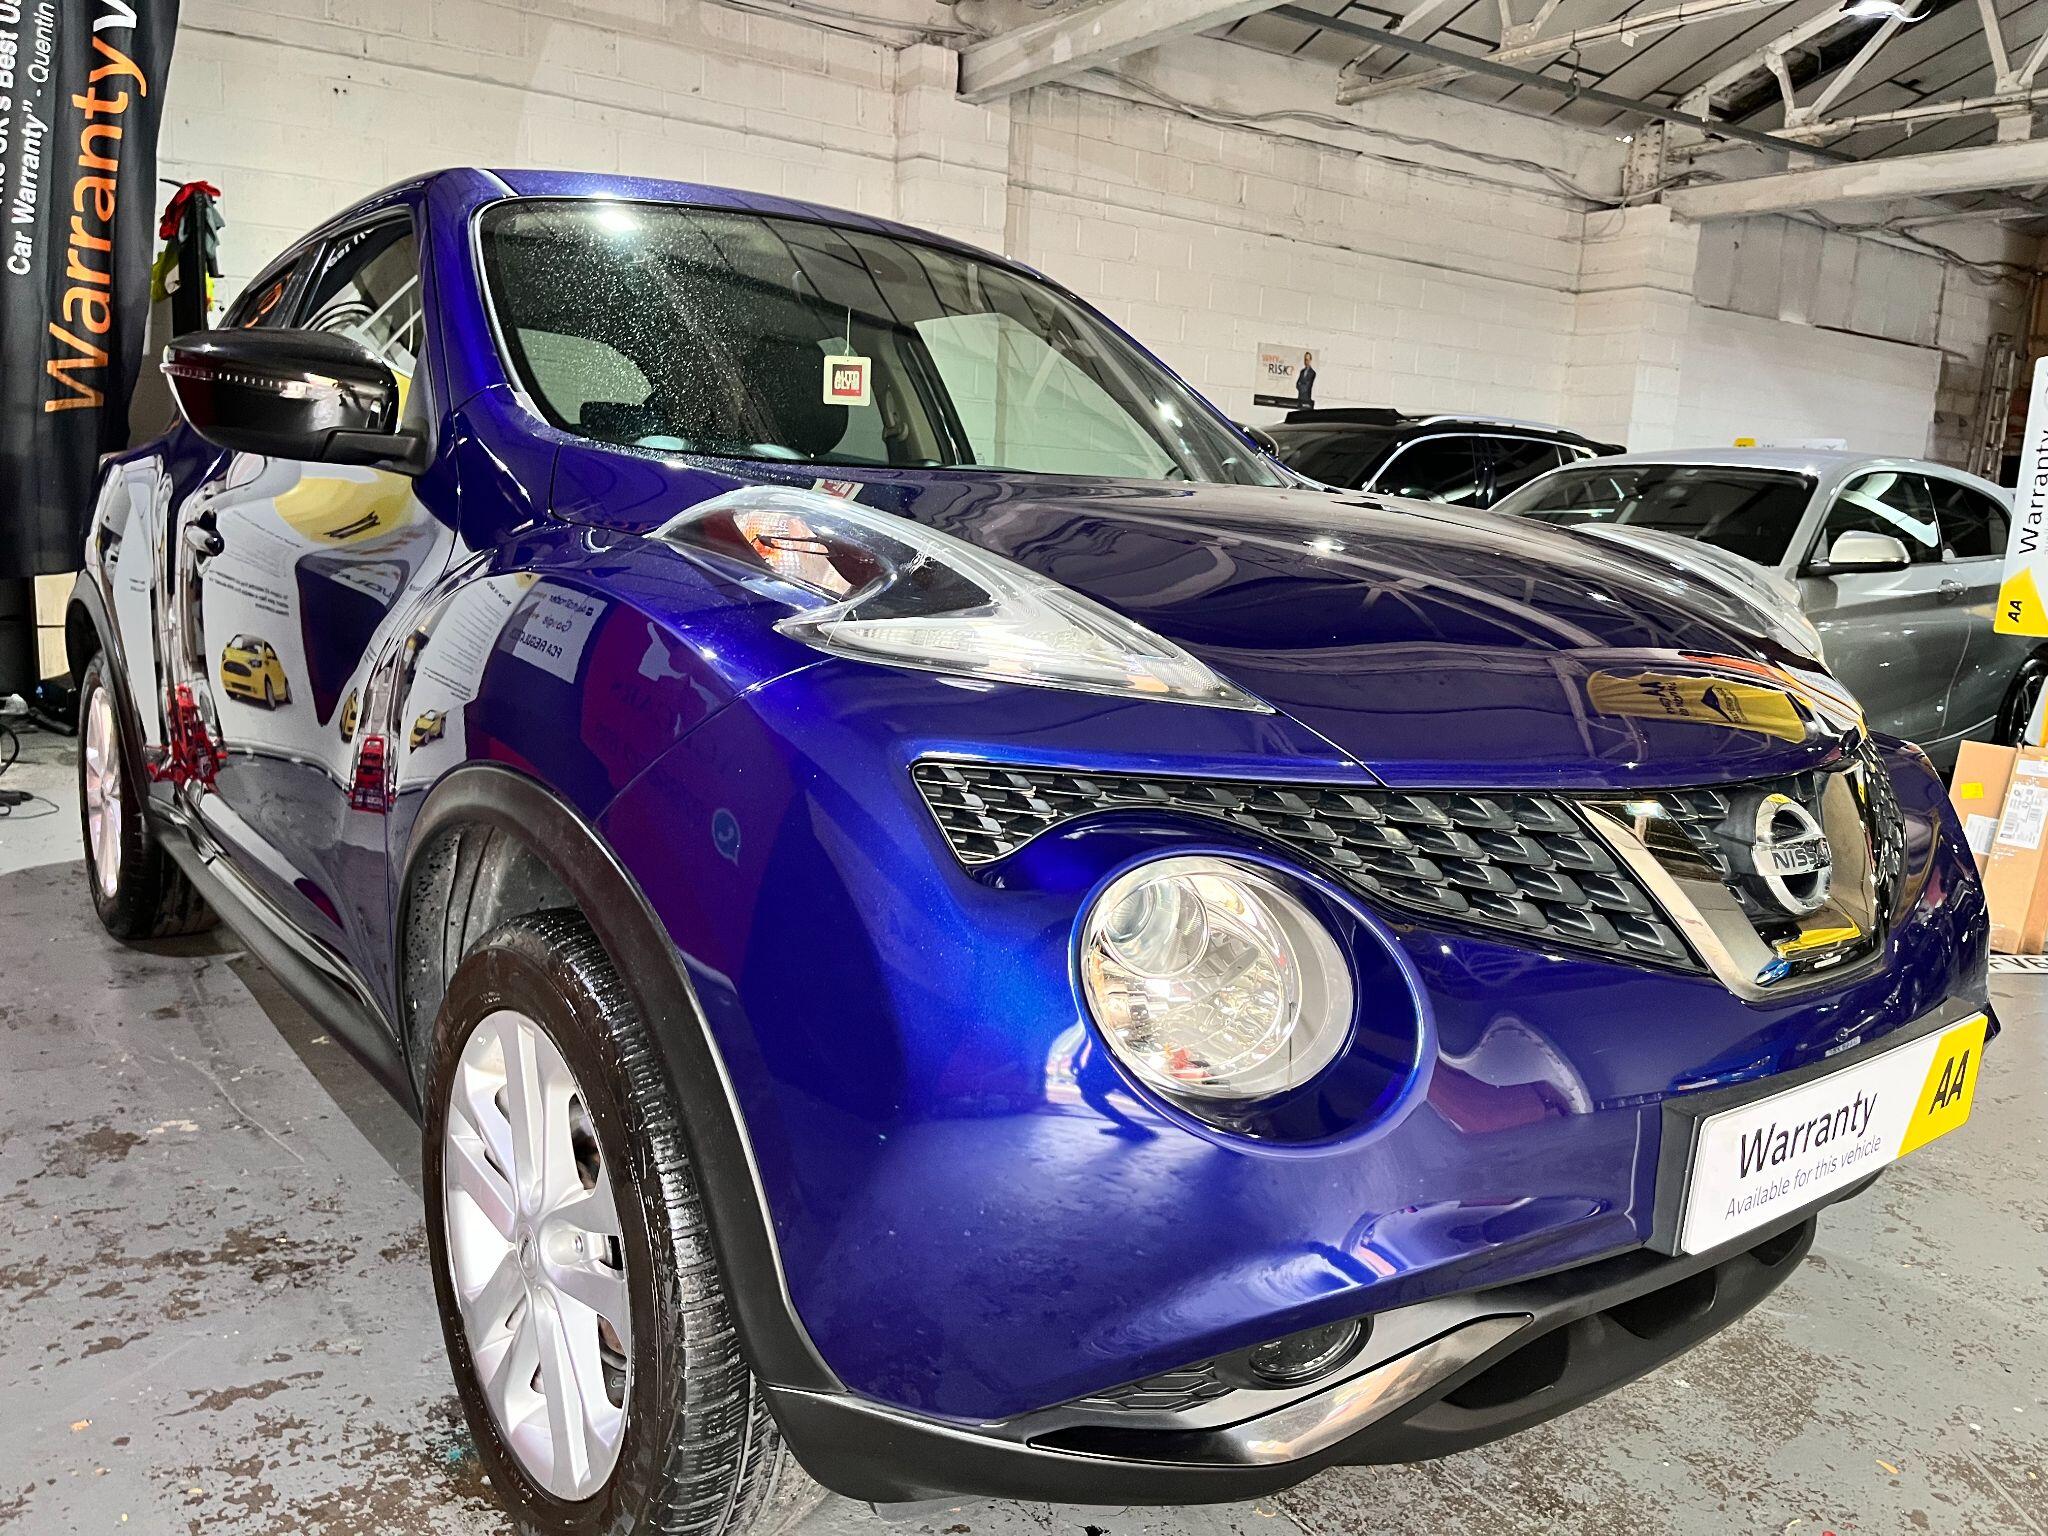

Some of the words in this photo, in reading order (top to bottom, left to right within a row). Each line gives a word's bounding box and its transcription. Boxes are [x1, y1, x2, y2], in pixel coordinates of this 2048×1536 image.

[7, 230, 33, 275] Car
[27, 2, 55, 83] Quentin
[2008, 600, 2023, 623] AA
[1739, 1089, 1879, 1180] Warranty
[1928, 1049, 1971, 1116] AA
[1725, 1176, 1790, 1221] Available
[1794, 1168, 1814, 1190] for
[1815, 1155, 1838, 1181] this
[1841, 1135, 1882, 1168] vehicle
